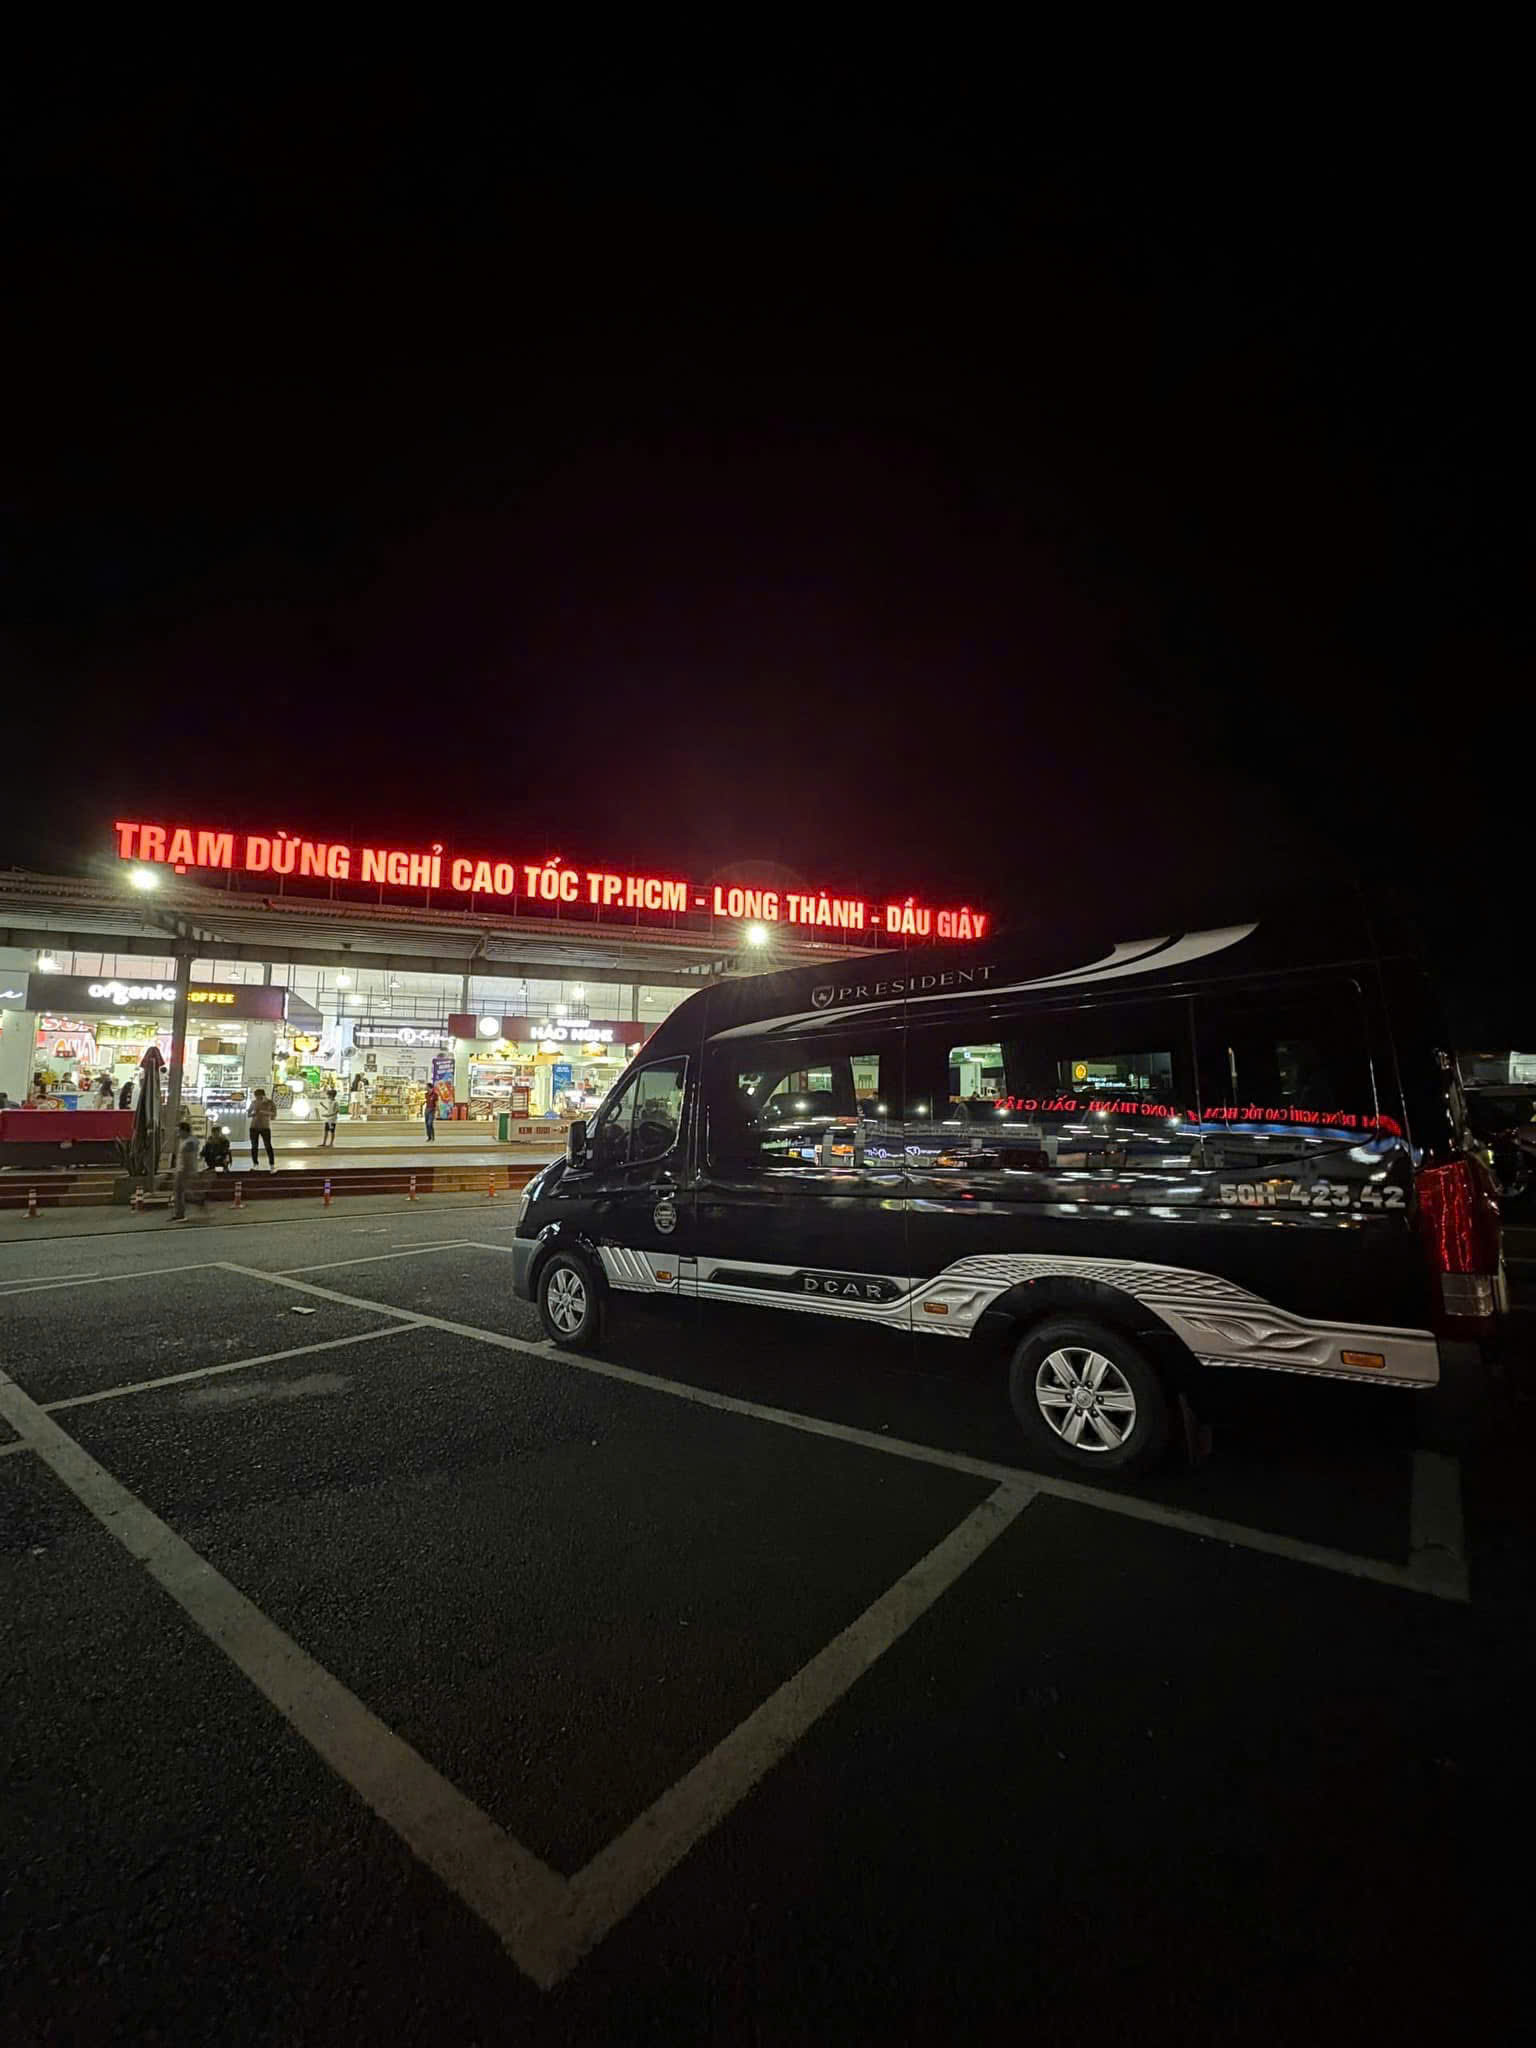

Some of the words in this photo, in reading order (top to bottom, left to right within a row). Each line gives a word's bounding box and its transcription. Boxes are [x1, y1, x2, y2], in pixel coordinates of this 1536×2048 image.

[115, 822, 234, 874] TRẠM
[246, 831, 350, 879] DỪNG
[361, 844, 443, 888] NGHỈ
[452, 859, 514, 895] CAO
[525, 857, 579, 902] TỐC
[587, 873, 687, 912] TP.HCM
[714, 886, 778, 921] LONG
[787, 892, 864, 929] THÀNH
[938, 907, 986, 940] GIÂY
[839, 965, 996, 1000] PRESIDENT
[187, 991, 235, 1004] OFFEE
[1220, 1183, 1406, 1208] 50H-423.42
[804, 1278, 881, 1298] DCAR
